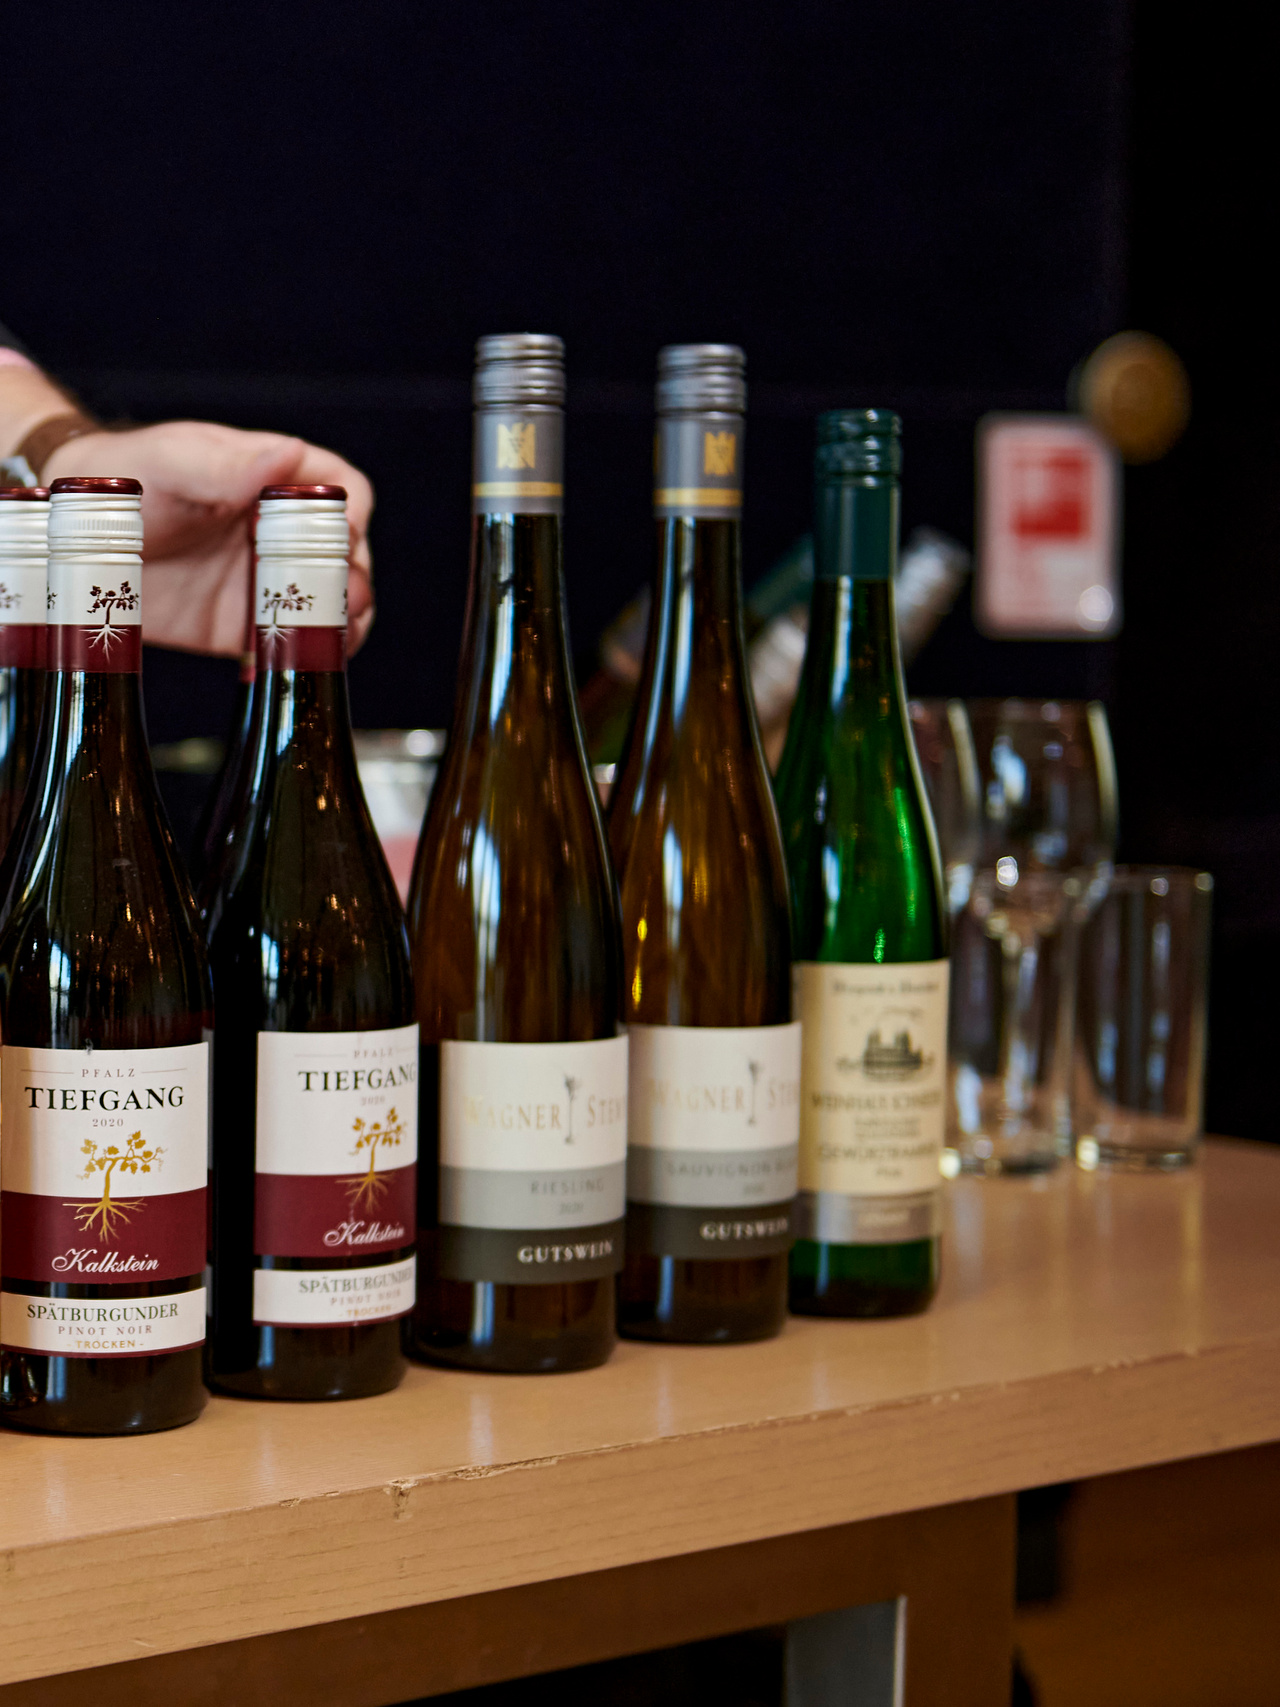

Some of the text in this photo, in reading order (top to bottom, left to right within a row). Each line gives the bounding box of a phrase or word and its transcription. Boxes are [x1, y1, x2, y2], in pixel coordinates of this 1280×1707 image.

[354, 1047, 394, 1059] PFALZ
[81, 1068, 136, 1078] PFALZ
[298, 1062, 417, 1092] TIEFGANG
[25, 1085, 184, 1111] TIEFGANG
[92, 1118, 124, 1128] 2020
[464, 1096, 562, 1130] WAGNER
[530, 1178, 604, 1195] RIESLING
[323, 1221, 404, 1247] Kalkstein
[51, 1248, 160, 1274] Kalkstein
[517, 1239, 613, 1264] GUTSWEIN
[27, 1302, 179, 1323] SPÄTBURGUNDER
[58, 1324, 153, 1336] PINOT NOIR
[77, 1339, 136, 1350] TROCKEN
